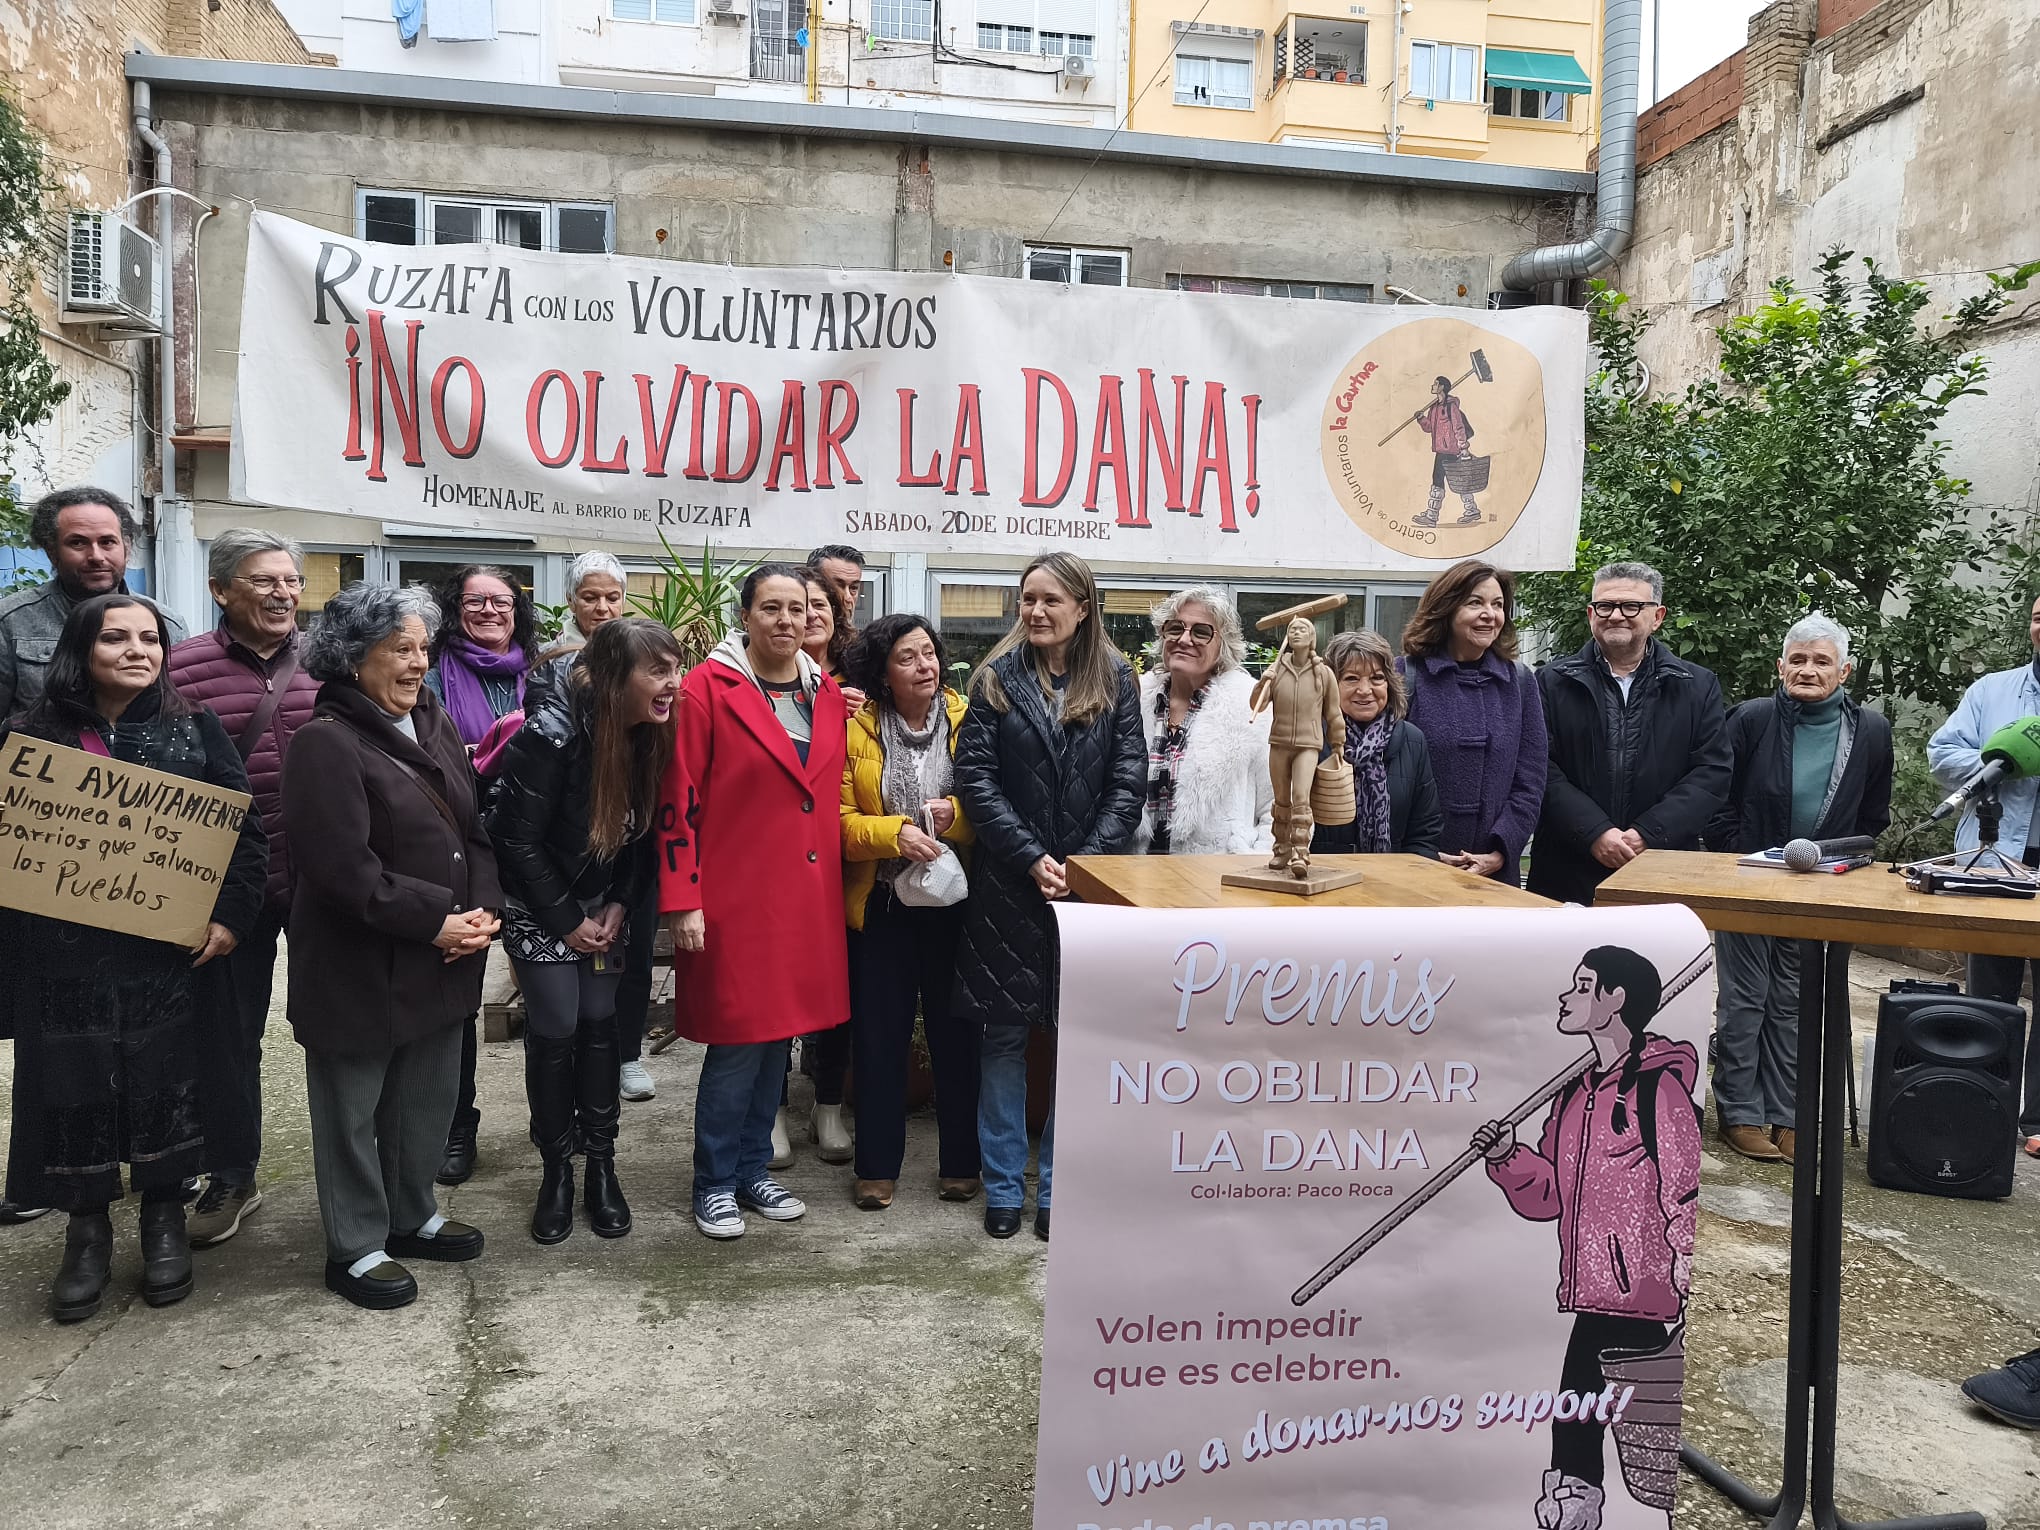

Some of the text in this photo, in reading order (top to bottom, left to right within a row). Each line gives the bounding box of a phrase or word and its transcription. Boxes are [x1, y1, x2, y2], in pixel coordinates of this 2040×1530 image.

[313, 241, 937, 352] RUZAFA CON LOS VOLUNTARIOS
[1329, 416, 1349, 431] la
[525, 364, 862, 492] OLVIDAR
[896, 383, 989, 497] LA
[1019, 367, 1263, 533] DANA!
[1337, 434, 1375, 516] Voluntarios
[422, 474, 751, 527] HOMENAJE AL BARRIO DE RUZAFA
[846, 510, 932, 533] SABADO,
[970, 514, 997, 533] DE
[1006, 516, 1111, 540] DICIEMBRE
[1377, 511, 1388, 521] de
[1389, 520, 1437, 545] Centro
[9, 746, 247, 832] EL AYUNTAMIENTO
[4, 786, 182, 843] Ningunea a los
[13, 844, 171, 911] los Pueblos
[99, 839, 136, 862] que
[143, 848, 222, 888] salvaron
[1172, 934, 1456, 1035] Premis
[1109, 1058, 1478, 1104] NO OBLIDAR
[1170, 1127, 1431, 1173] LA DANA
[1297, 1183, 1343, 1197] Paco
[1349, 1183, 1394, 1197] Roca
[1096, 1308, 1362, 1345] Volen impedir
[1093, 1353, 1401, 1395] que es celebren.
[1086, 1383, 1635, 1506] Vine a donar-nos suport!
